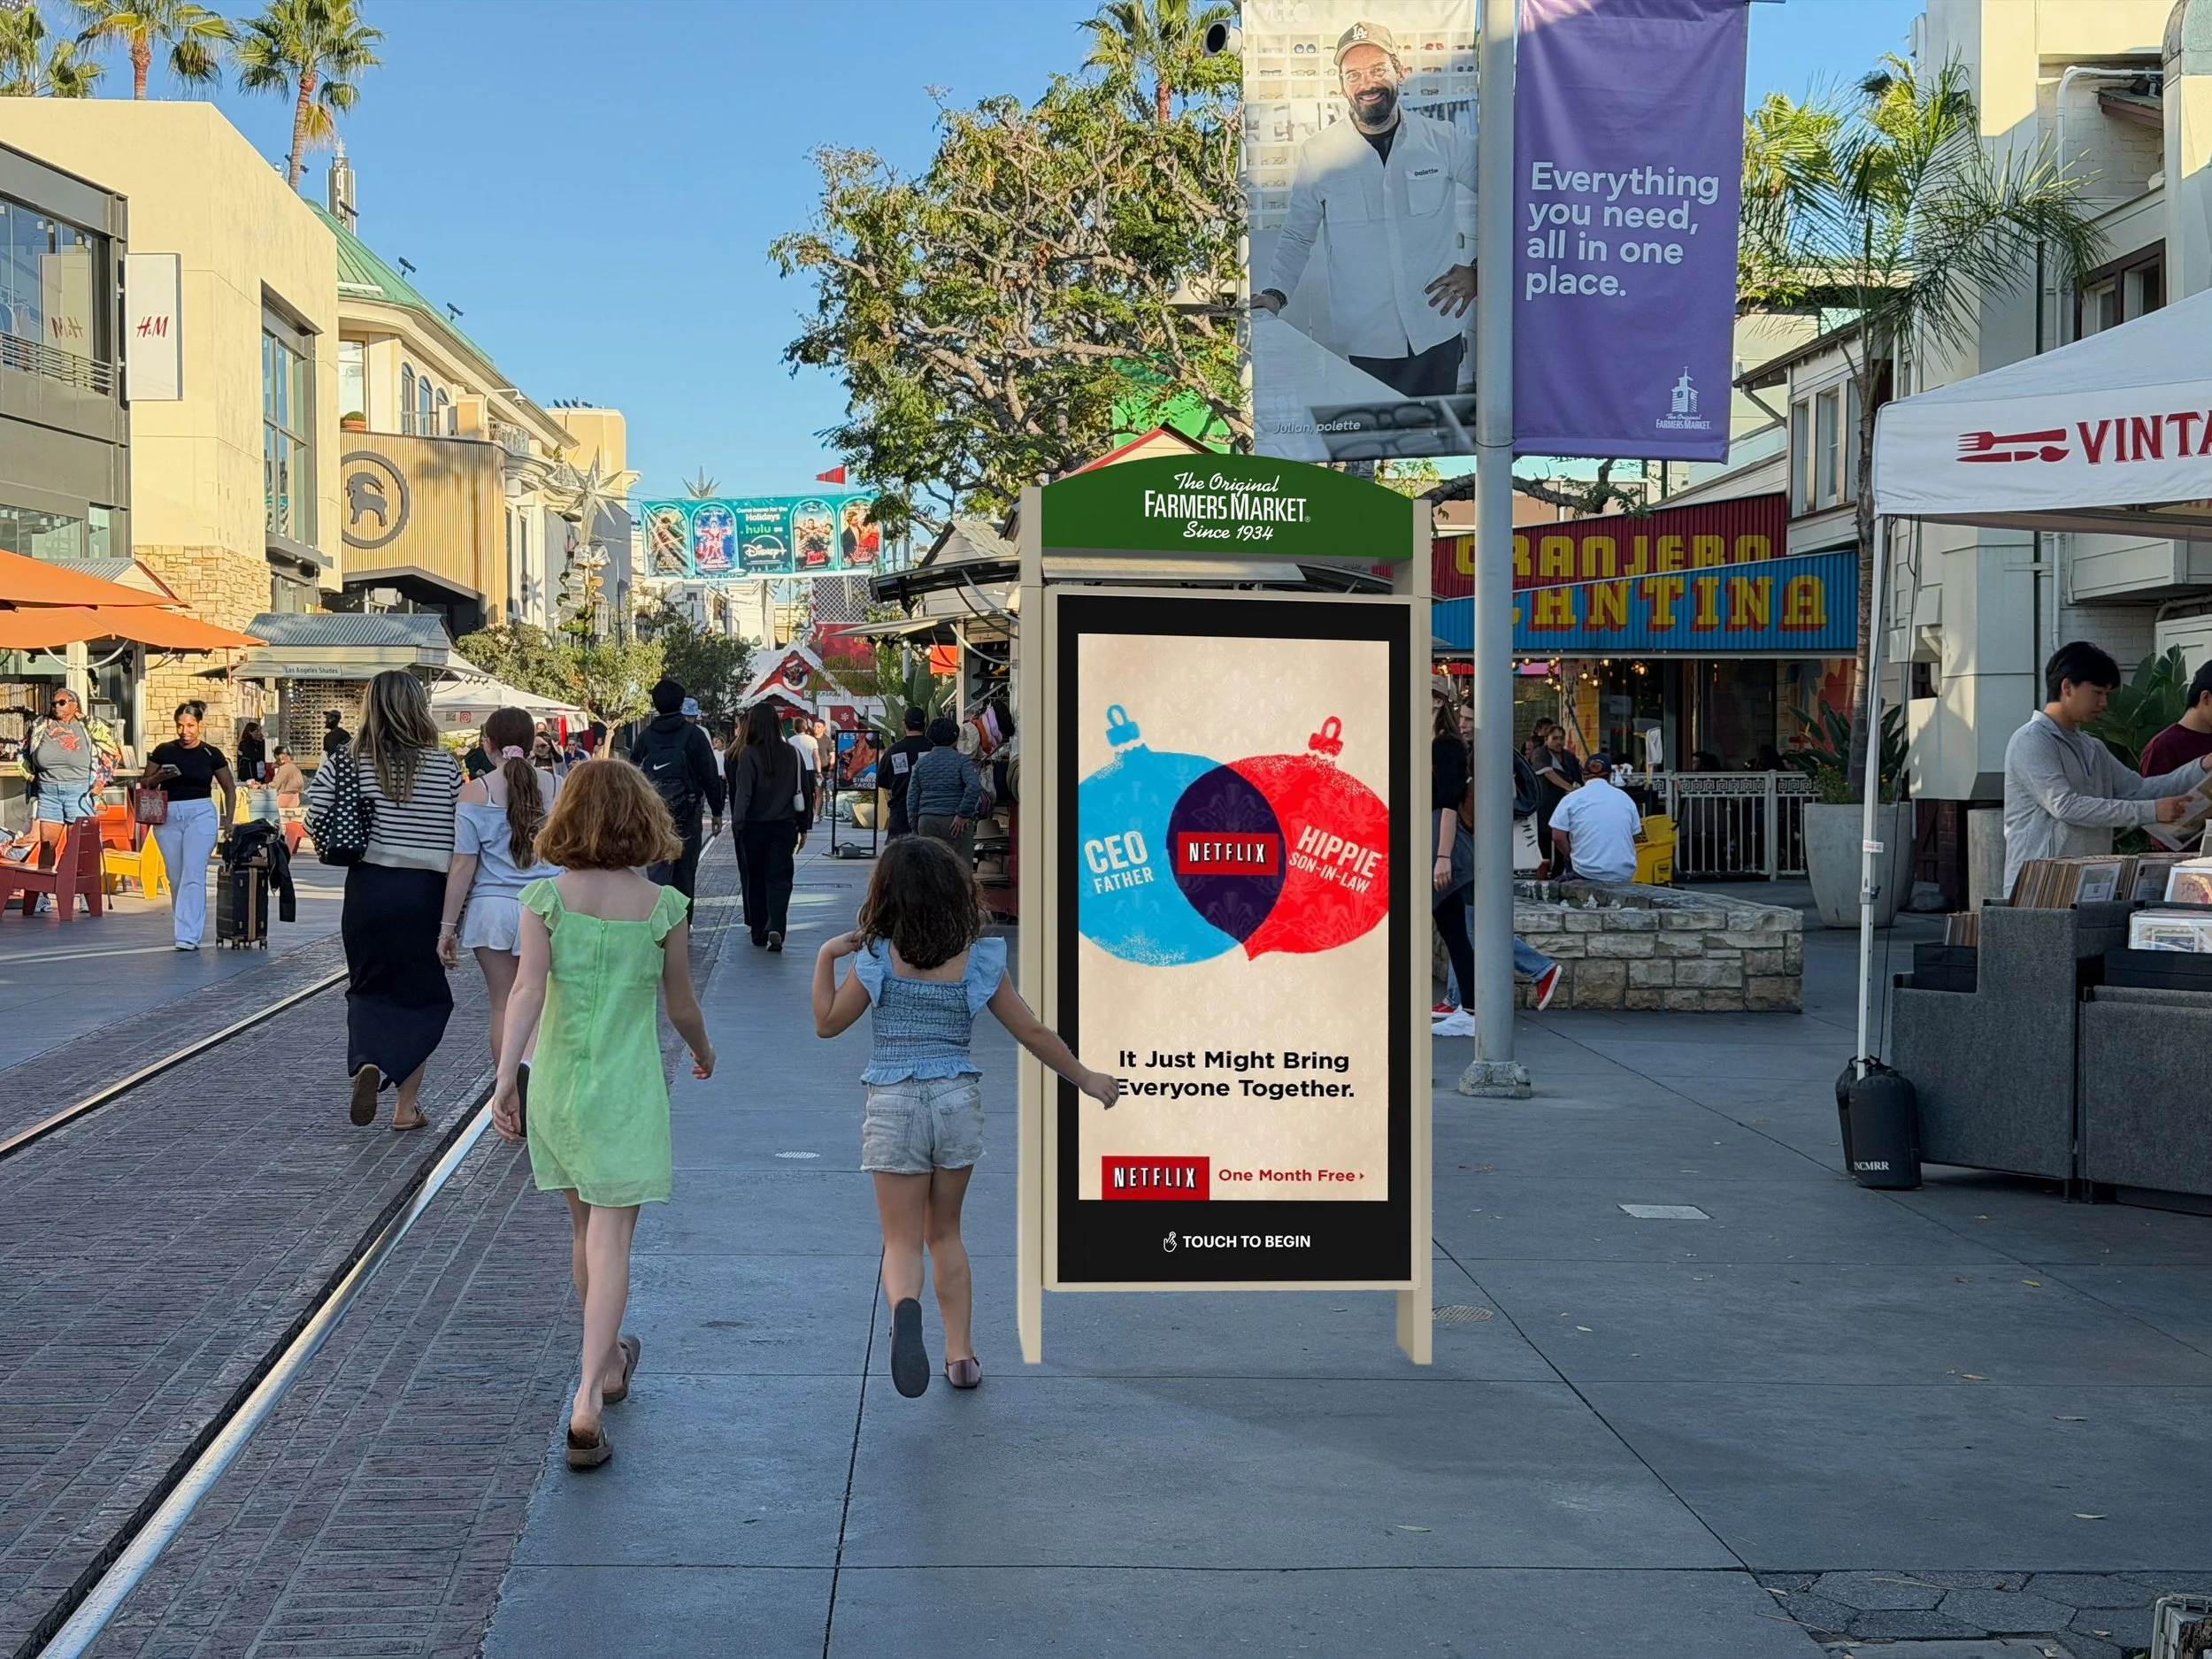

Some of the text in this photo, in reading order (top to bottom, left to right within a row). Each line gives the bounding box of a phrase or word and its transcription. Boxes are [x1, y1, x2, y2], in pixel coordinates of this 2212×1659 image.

[1532, 162, 1719, 204] Everything
[1527, 200, 1699, 235] you need,
[1526, 229, 1684, 265] all in one
[1525, 265, 1627, 301] place.
[137, 316, 169, 338] H&M
[1274, 420, 1361, 434] Julian, polette
[1655, 419, 1684, 429] FARMERS
[1173, 472, 1280, 497] The Original
[1145, 490, 1227, 519] FARMERS
[745, 524, 772, 534] hulu
[746, 513, 780, 522] Holidays
[1183, 520, 1273, 541] Since 1934
[1513, 574, 1827, 629] ANTINA
[1084, 830, 1148, 874] CEO
[1189, 842, 1265, 864] NETFLIX
[1296, 825, 1382, 879] HIPPIE
[1094, 867, 1154, 895] FATHER
[1288, 852, 1371, 894] SON-IN-LAW
[1119, 1050, 1349, 1073] It Just Might Bring
[1118, 1078, 1355, 1100] Everyone Together.
[1114, 1167, 1195, 1188] NETFLIX
[1218, 1169, 1356, 1182] One Month Free
[1183, 1234, 1311, 1248] TOUCH TO BEGIN
